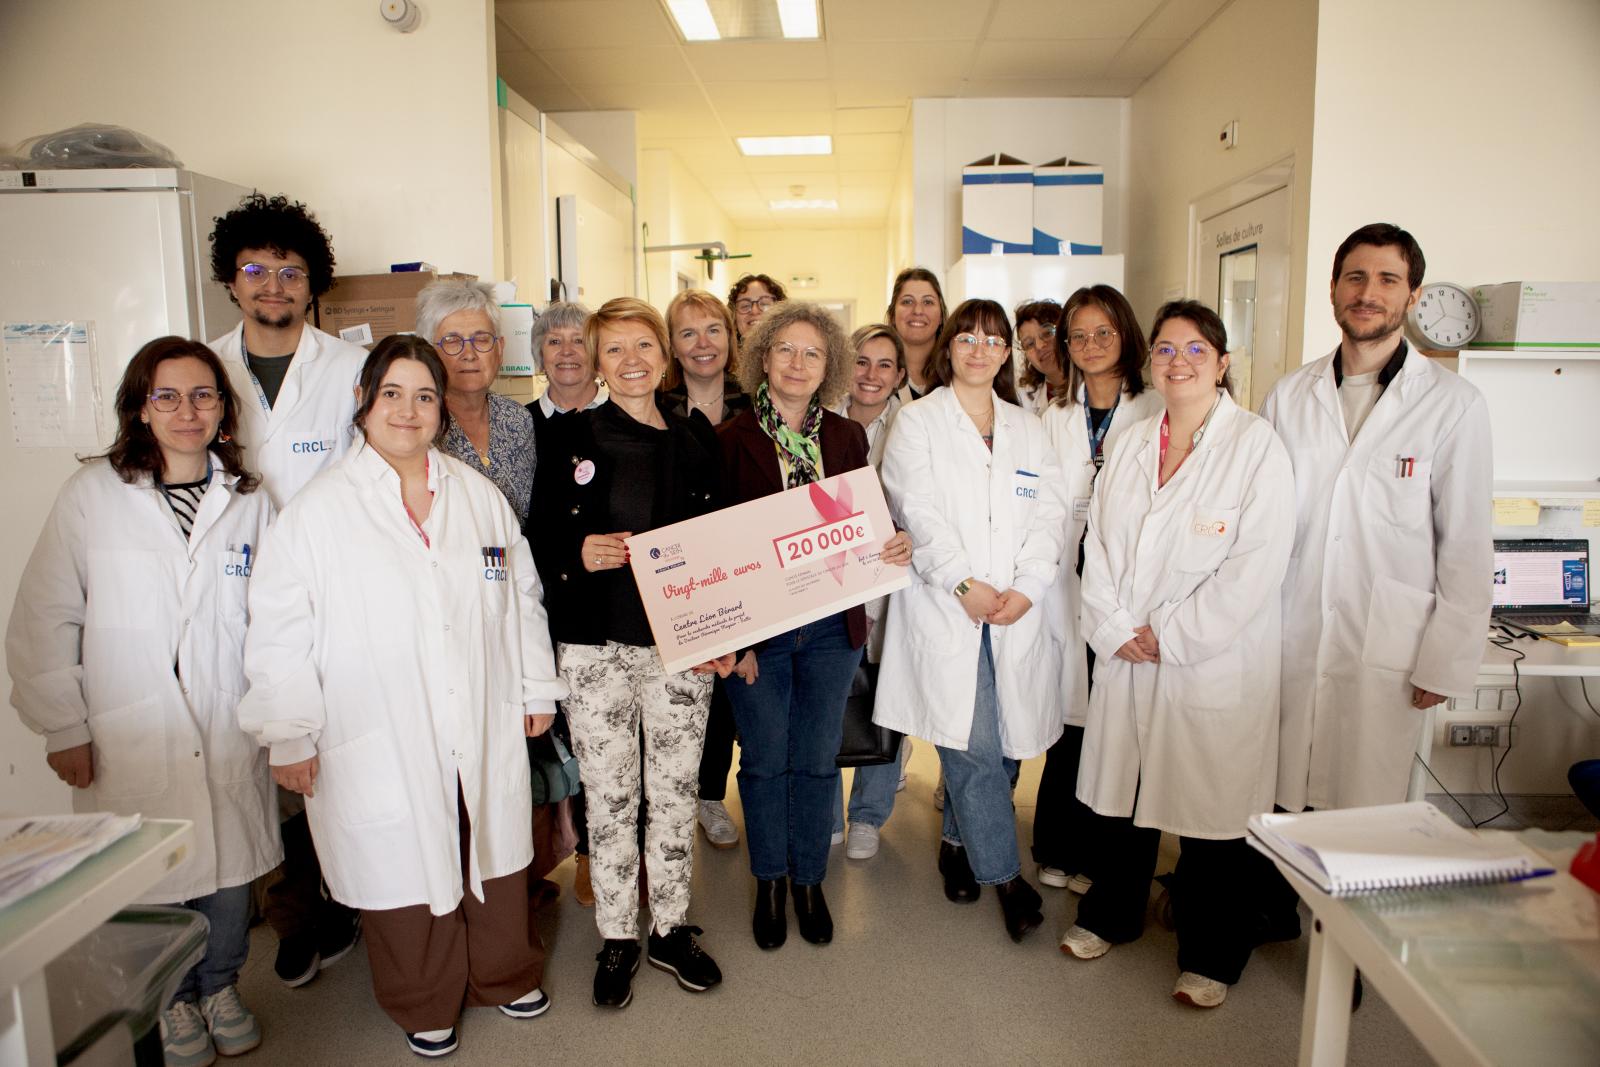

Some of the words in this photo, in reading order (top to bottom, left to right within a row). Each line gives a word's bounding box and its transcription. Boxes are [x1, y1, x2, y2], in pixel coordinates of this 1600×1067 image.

[1216, 231, 1232, 248] Salles
[1233, 227, 1240, 242] de
[1241, 222, 1264, 240] culture
[292, 440, 328, 453] CRCL
[787, 537, 813, 560] 20
[818, 524, 864, 550] 000€
[224, 564, 250, 577] CRC
[662, 566, 728, 600] Vingt-mille
[734, 560, 762, 576] euros
[673, 620, 698, 632] Centre
[700, 612, 717, 624] Léon
[716, 600, 743, 617] Bérard
